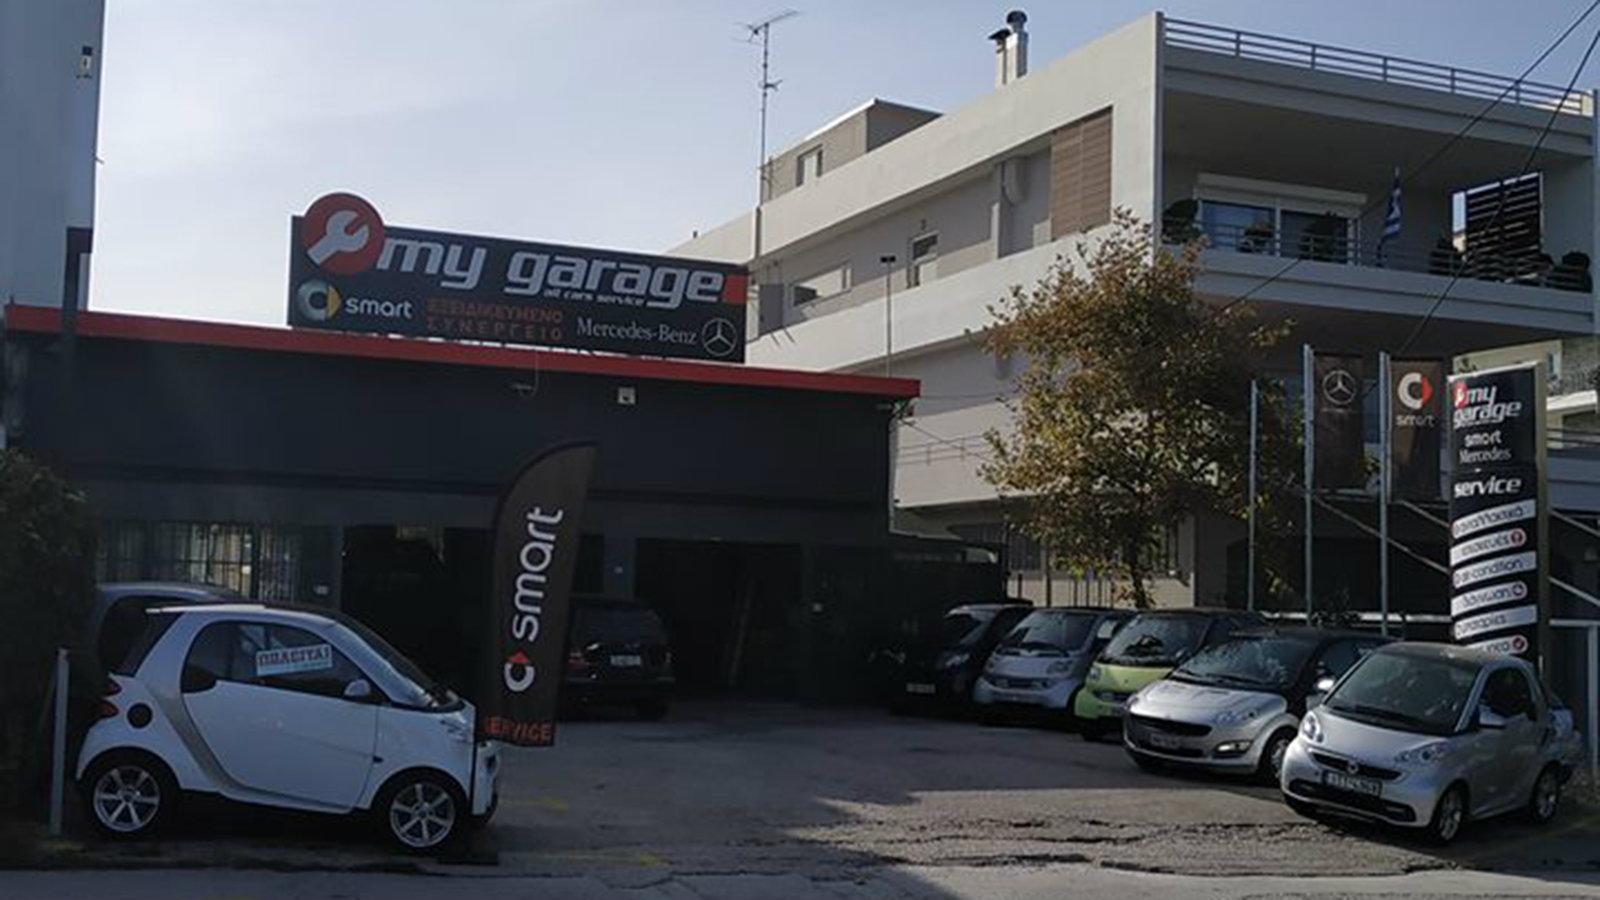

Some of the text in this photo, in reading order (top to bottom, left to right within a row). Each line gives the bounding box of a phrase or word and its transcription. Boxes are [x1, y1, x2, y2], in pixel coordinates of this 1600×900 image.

[376, 238, 726, 309] my garage
[345, 298, 413, 320] smart
[576, 316, 698, 345] Mercedes-Benz
[1453, 401, 1522, 429] garage
[1454, 476, 1522, 498] service
[512, 506, 564, 642] smart
[485, 715, 552, 741] ERVICE
